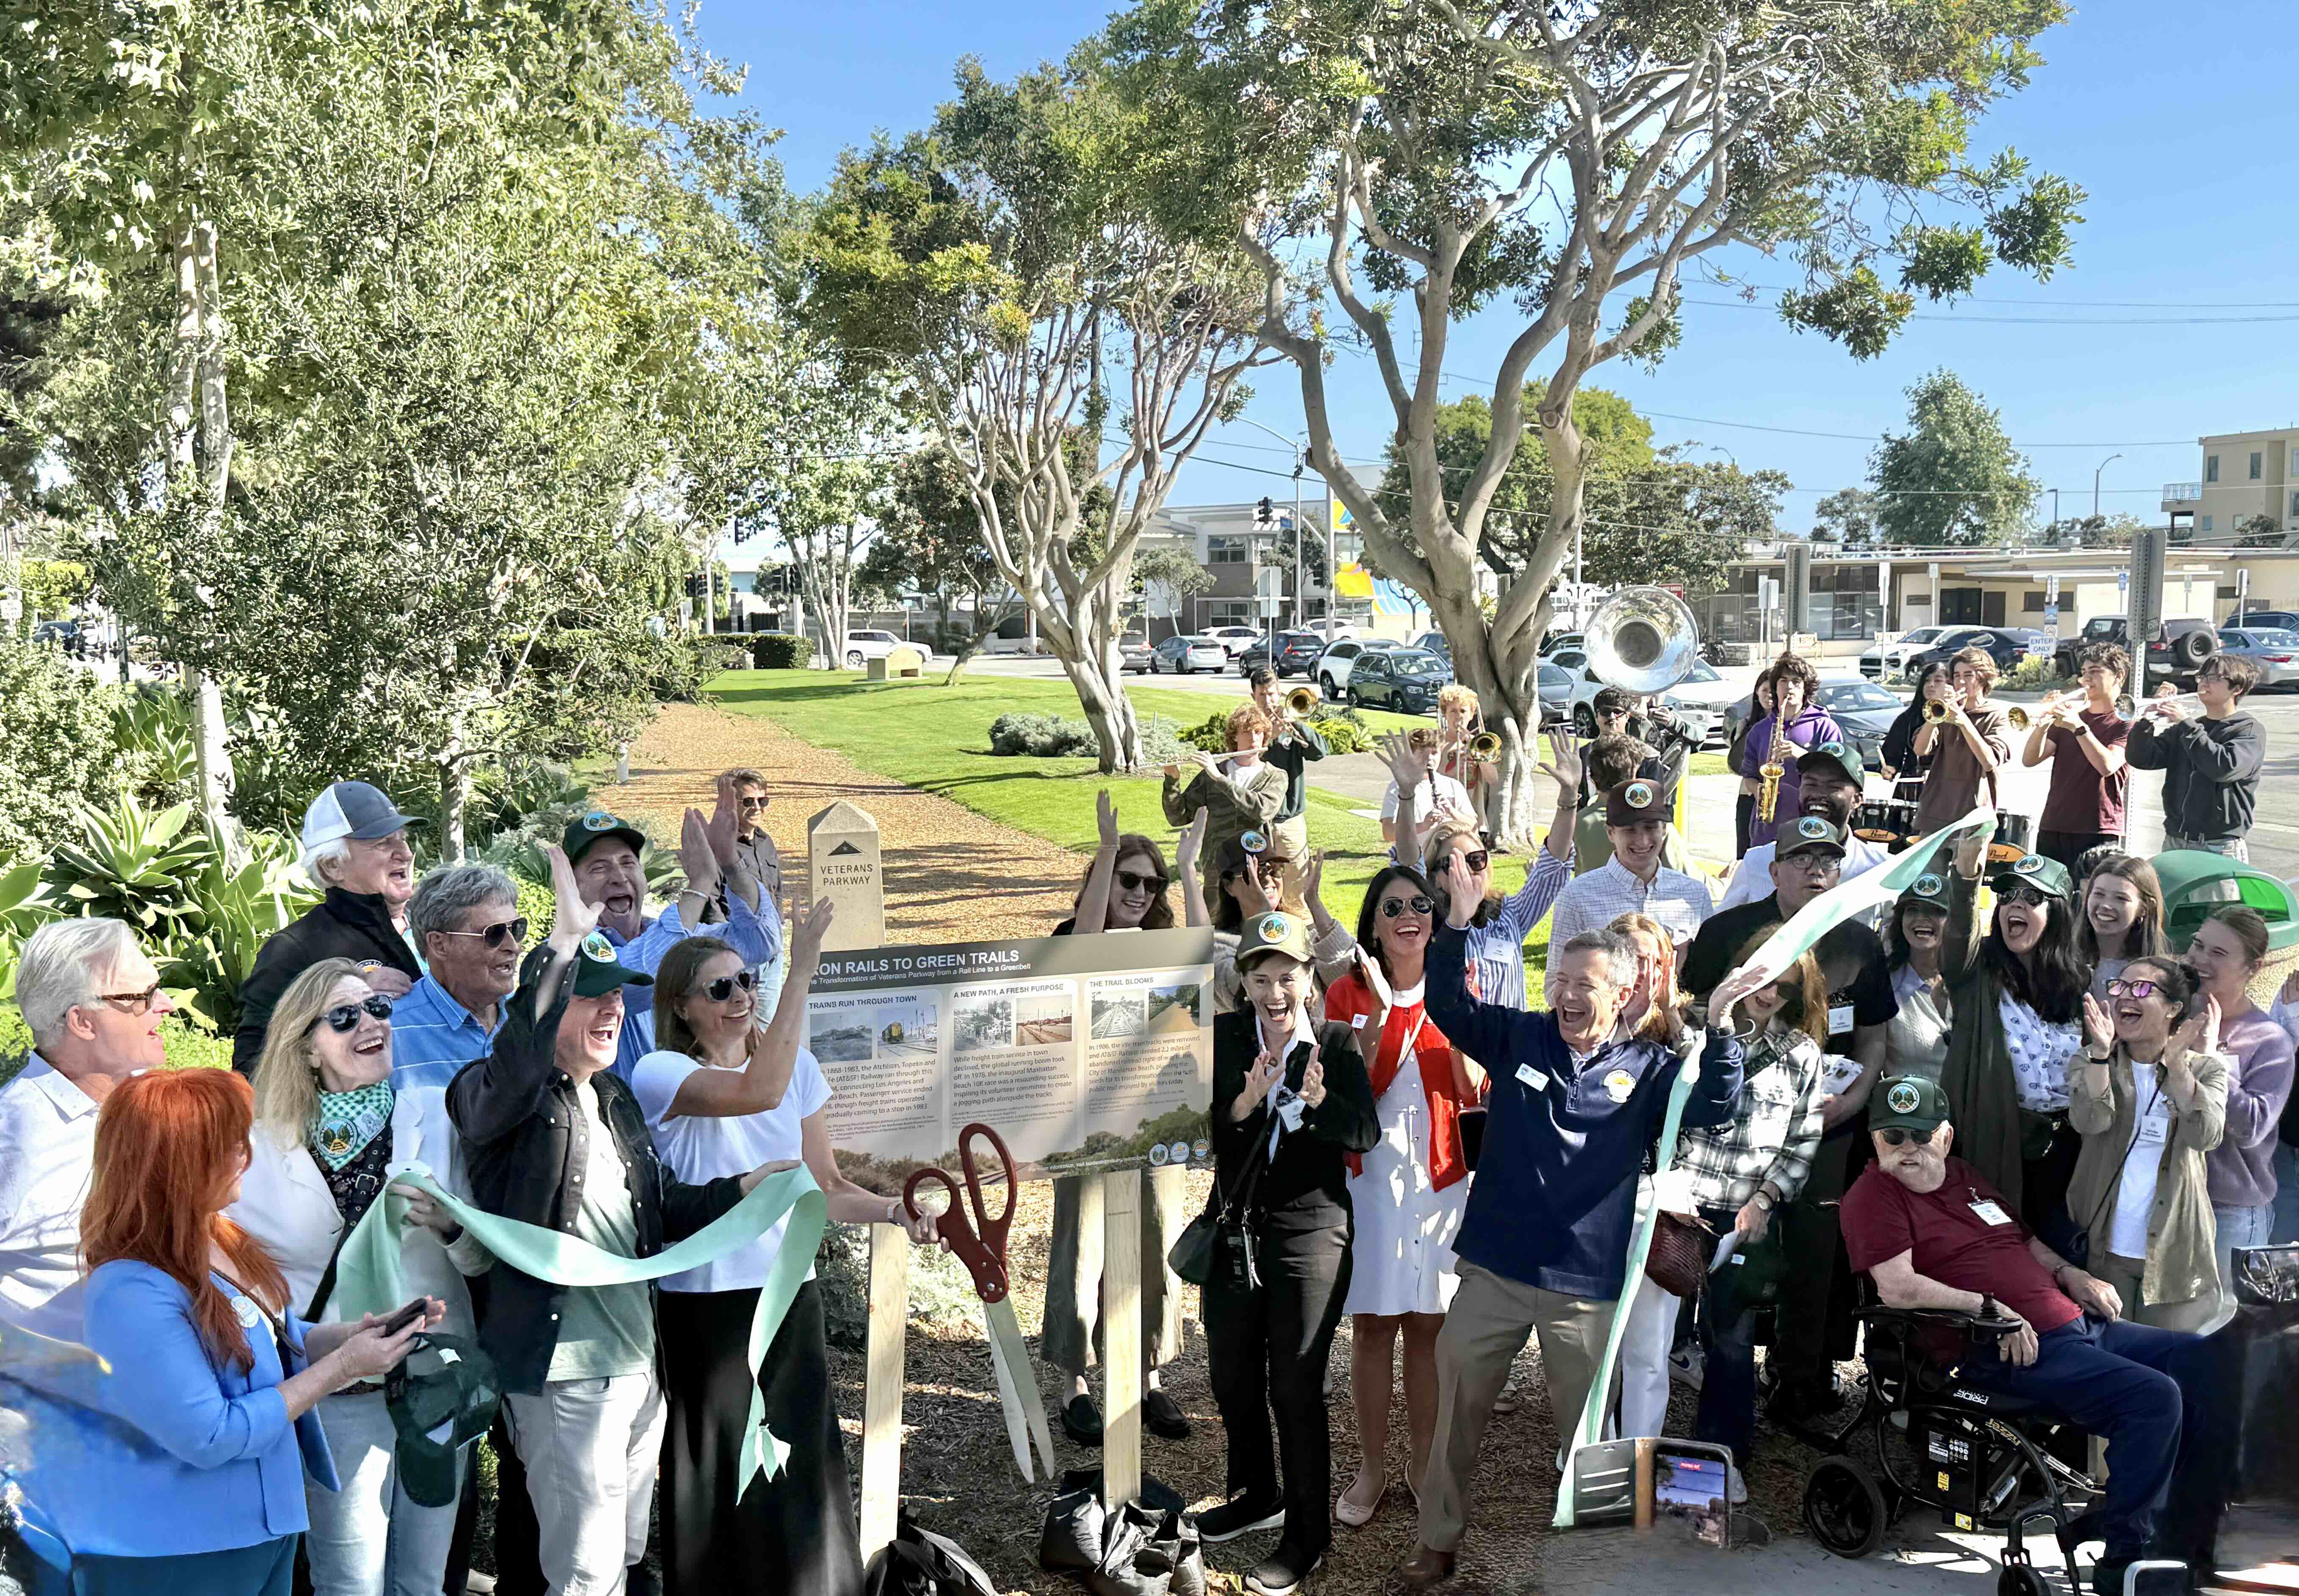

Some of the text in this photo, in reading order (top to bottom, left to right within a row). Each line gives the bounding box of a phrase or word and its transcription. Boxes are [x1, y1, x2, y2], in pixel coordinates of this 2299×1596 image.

[820, 864, 873, 874] VETERANS
[823, 876, 870, 885] PARKWAY
[814, 950, 1019, 976] ON RAILS TO GREEN TRAILS
[819, 975, 868, 985] Transformation
[879, 972, 906, 980] Veterans
[909, 970, 936, 978] Parkway
[1000, 963, 1031, 971] Greenbelt
[1125, 977, 1154, 985] BLOOMS
[1031, 983, 1064, 992] PURPOSE
[809, 1001, 837, 1009] TRAINS
[856, 997, 893, 1006] THROUGH
[971, 1054, 990, 1062] freight
[953, 1064, 979, 1072] declined,
[999, 1068, 1025, 1077] inaugural
[861, 1072, 884, 1080] Railway
[896, 1069, 920, 1078] through
[1015, 1075, 1046, 1083] resounding
[840, 1082, 874, 1091] connecting
[887, 1079, 911, 1087] Angeles
[860, 1090, 889, 1098] Passenger
[954, 1090, 978, 1098] inspiring
[897, 1095, 925, 1104] operated
[958, 1098, 981, 1106] jogging
[996, 1094, 1024, 1102] alongside
[826, 1111, 852, 1119] gradually
[854, 1109, 878, 1117] coming
[1955, 1389, 1989, 1405] PRIDE
